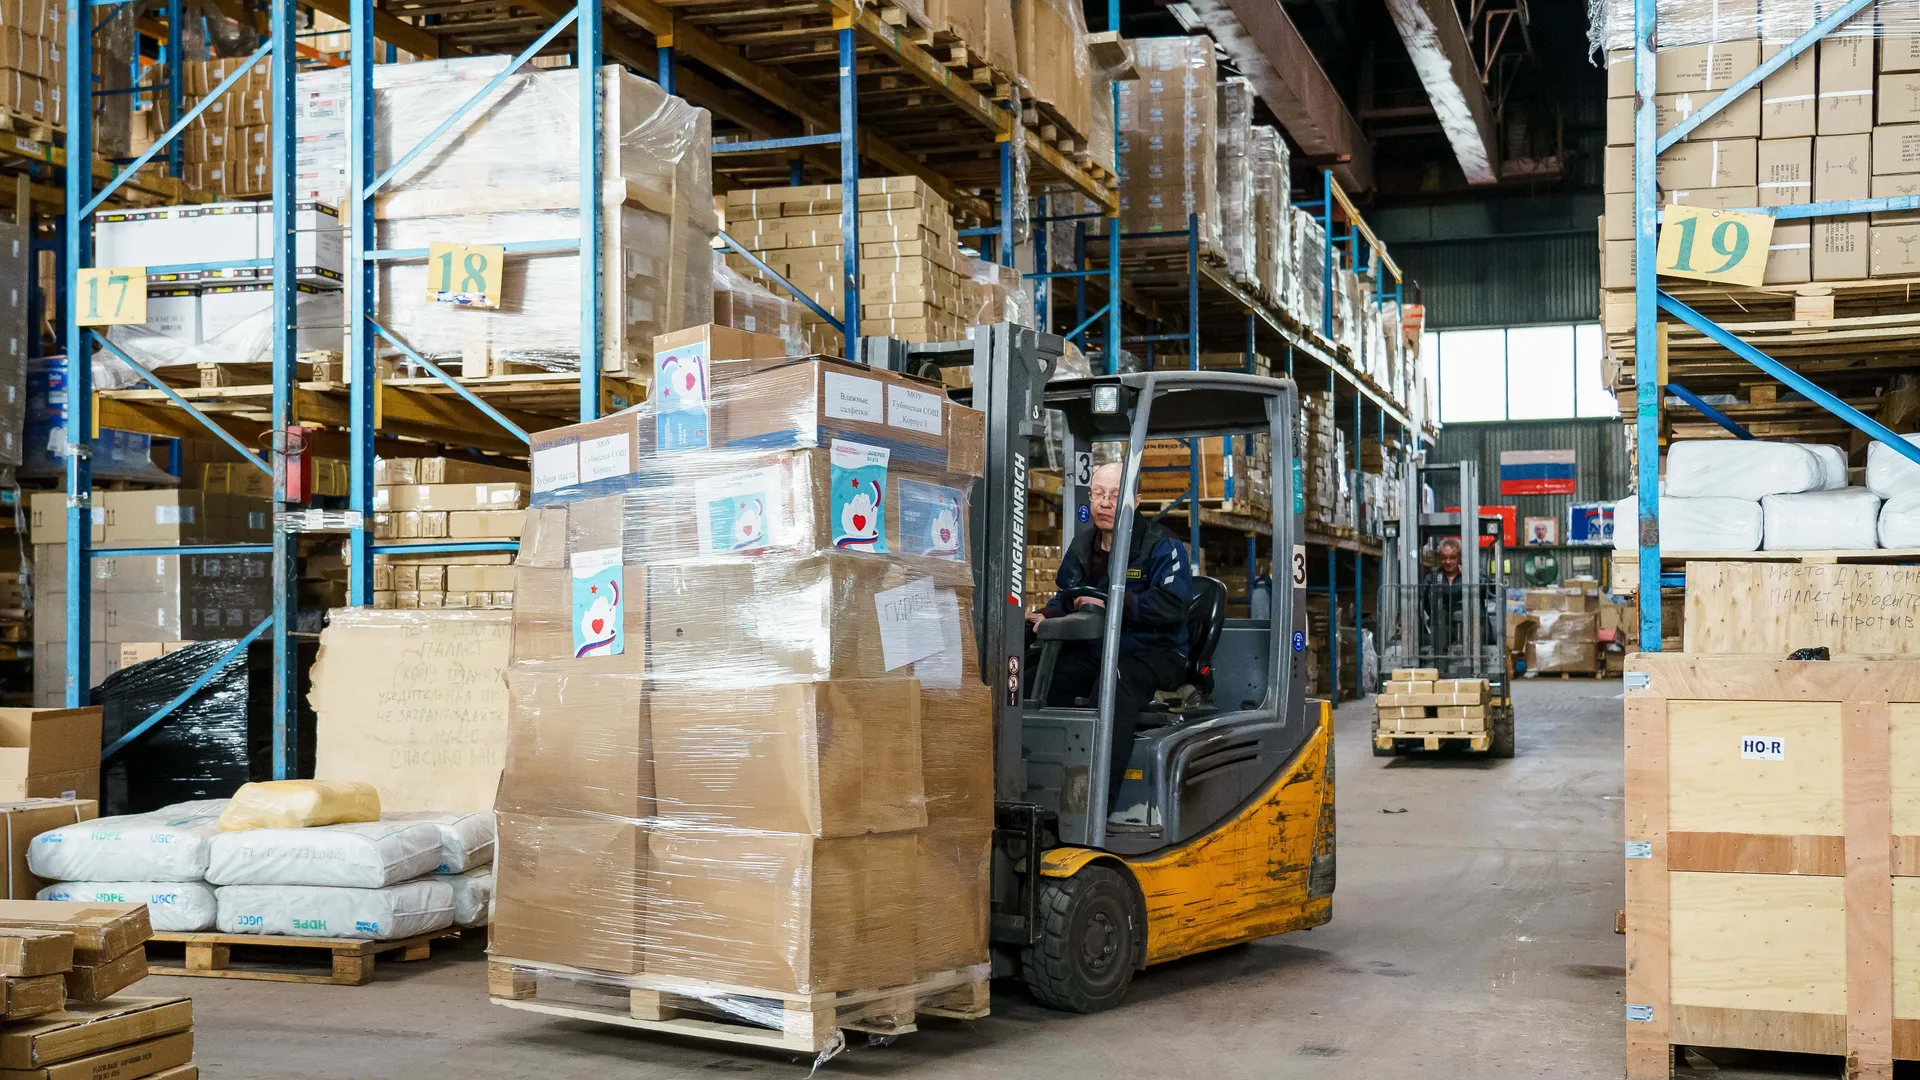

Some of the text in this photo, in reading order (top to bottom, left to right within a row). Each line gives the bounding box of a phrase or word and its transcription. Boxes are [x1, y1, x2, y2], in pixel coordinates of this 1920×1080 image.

[1667, 217, 1750, 274] 19
[436, 251, 488, 292] 18
[83, 275, 129, 318] 17
[840, 392, 868, 404] Влажные
[907, 391, 922, 400] МОУ
[840, 406, 868, 417] салфетки
[893, 400, 938, 417] Губинская СОШ
[902, 416, 924, 428] Корпус
[597, 439, 610, 448] МОУ
[612, 449, 627, 458] СОШ
[594, 466, 611, 476] Корпус
[1080, 454, 1090, 484] 3
[536, 471, 576, 488] Зубная паста
[1008, 452, 1026, 608] JUNGHEINRICH
[1293, 553, 1306, 584] 3
[1814, 612, 1914, 631] НАПРОТИВ
[1744, 740, 1781, 754] HO-R
[391, 749, 462, 769] СПАСИБО
[91, 831, 124, 842] HDPE
[95, 892, 125, 902] HDPE
[294, 919, 326, 930] HDPE
